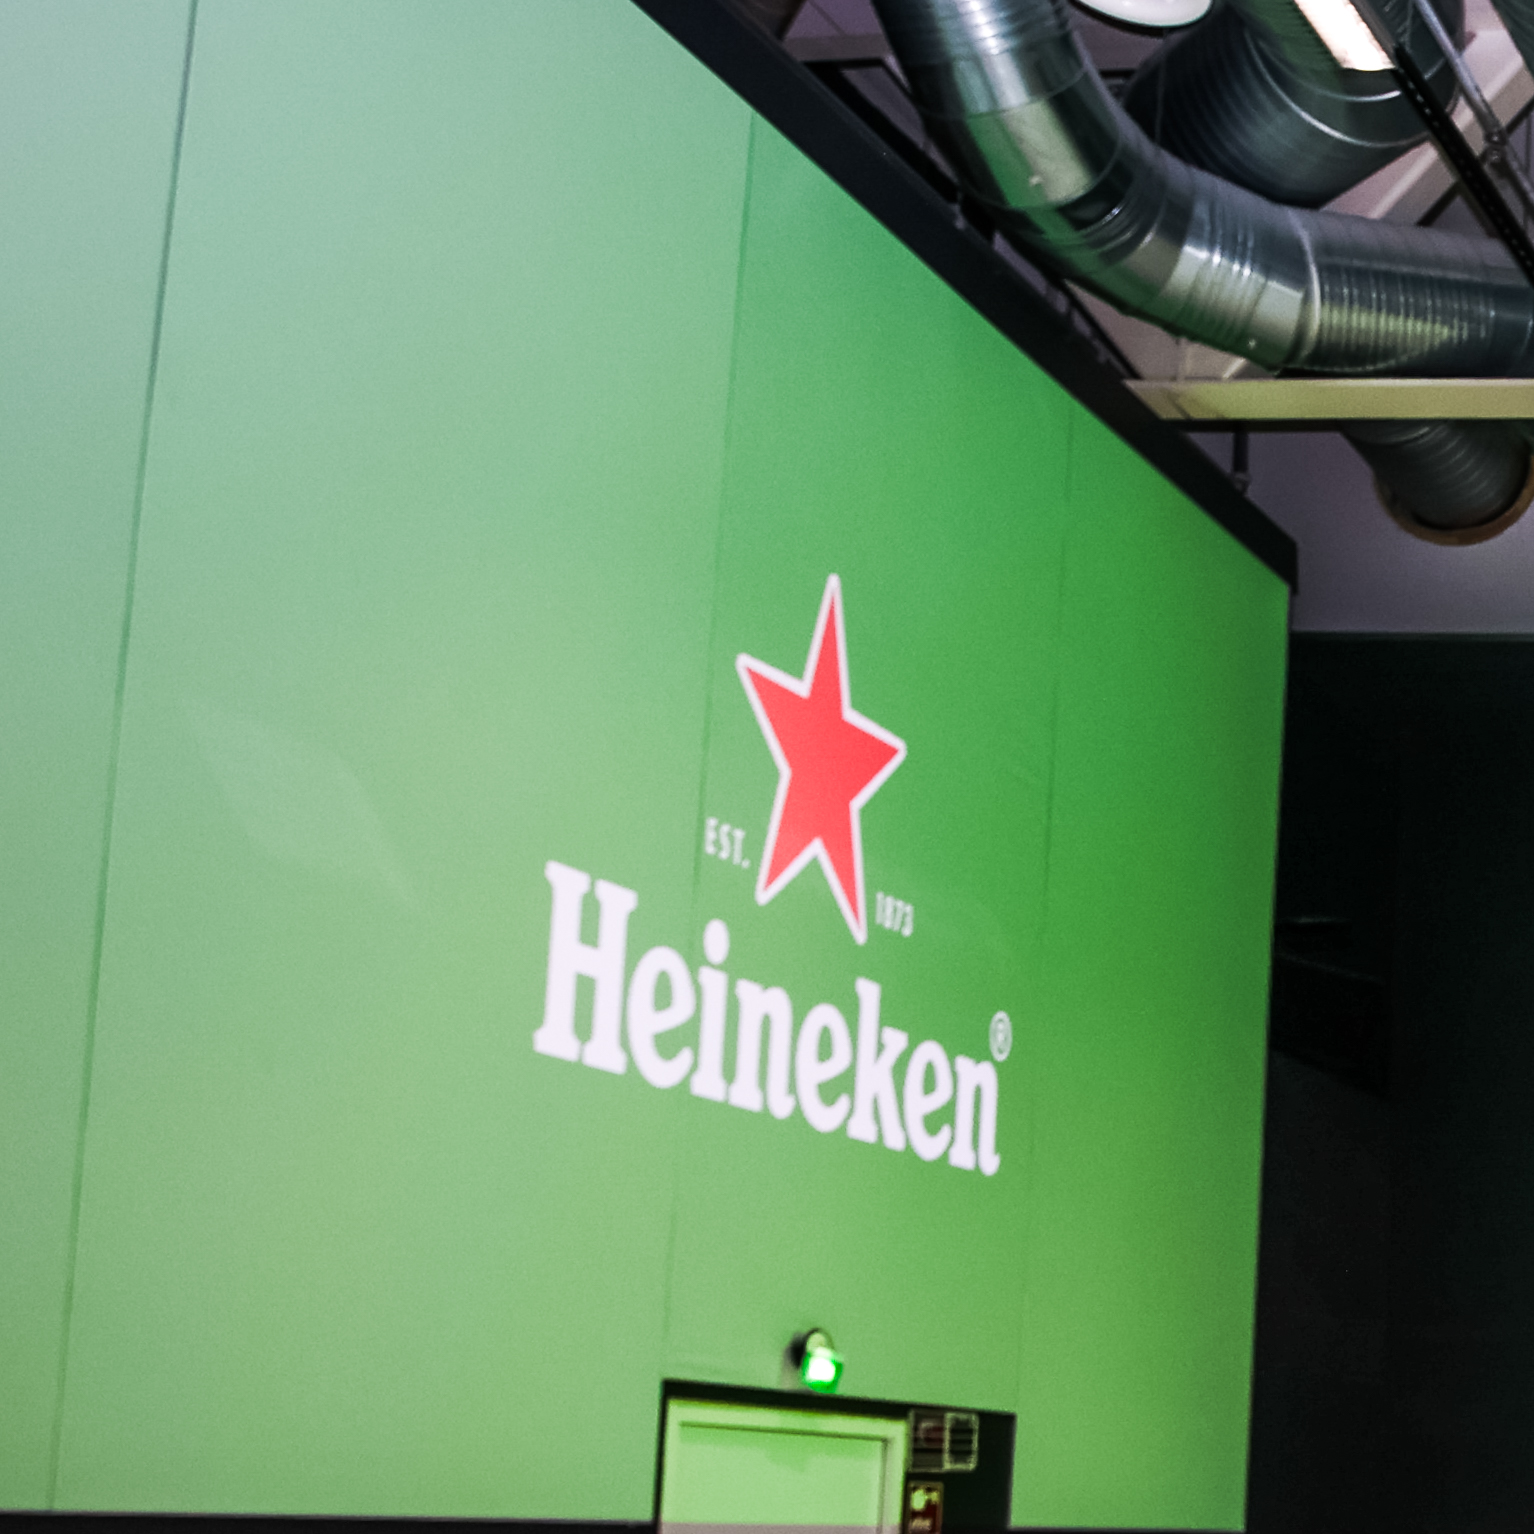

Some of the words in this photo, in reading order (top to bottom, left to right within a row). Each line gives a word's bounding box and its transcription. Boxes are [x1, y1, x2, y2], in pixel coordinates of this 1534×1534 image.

[705, 816, 750, 869] EST.
[875, 891, 914, 938] 1873
[532, 860, 1001, 1177] Heineken
